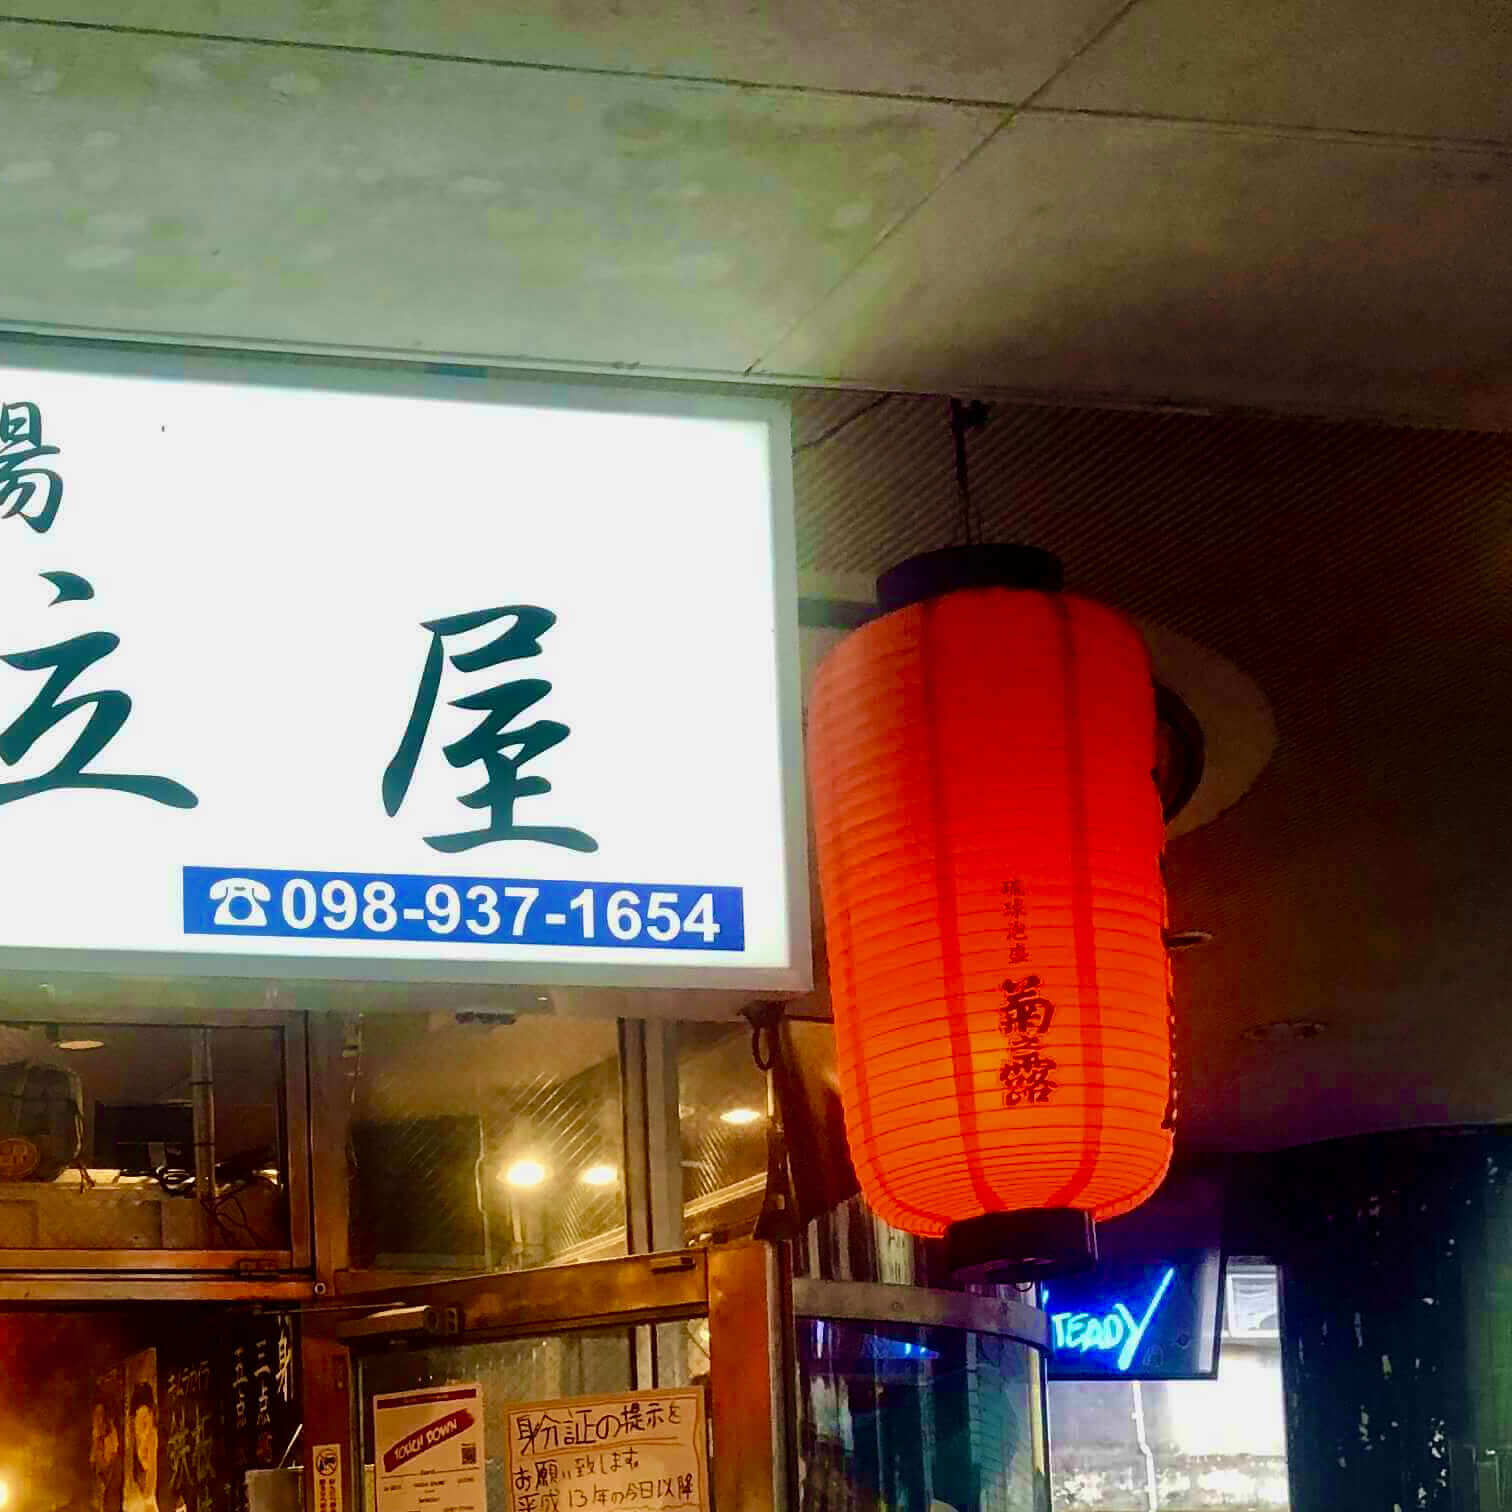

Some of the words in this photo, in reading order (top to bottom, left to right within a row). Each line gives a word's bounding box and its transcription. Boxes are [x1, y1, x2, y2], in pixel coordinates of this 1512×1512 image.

[281, 877, 721, 943] 098-937-1654
[425, 1418, 458, 1446] DOWN
[516, 1402, 682, 1457] 身分証の提示を
